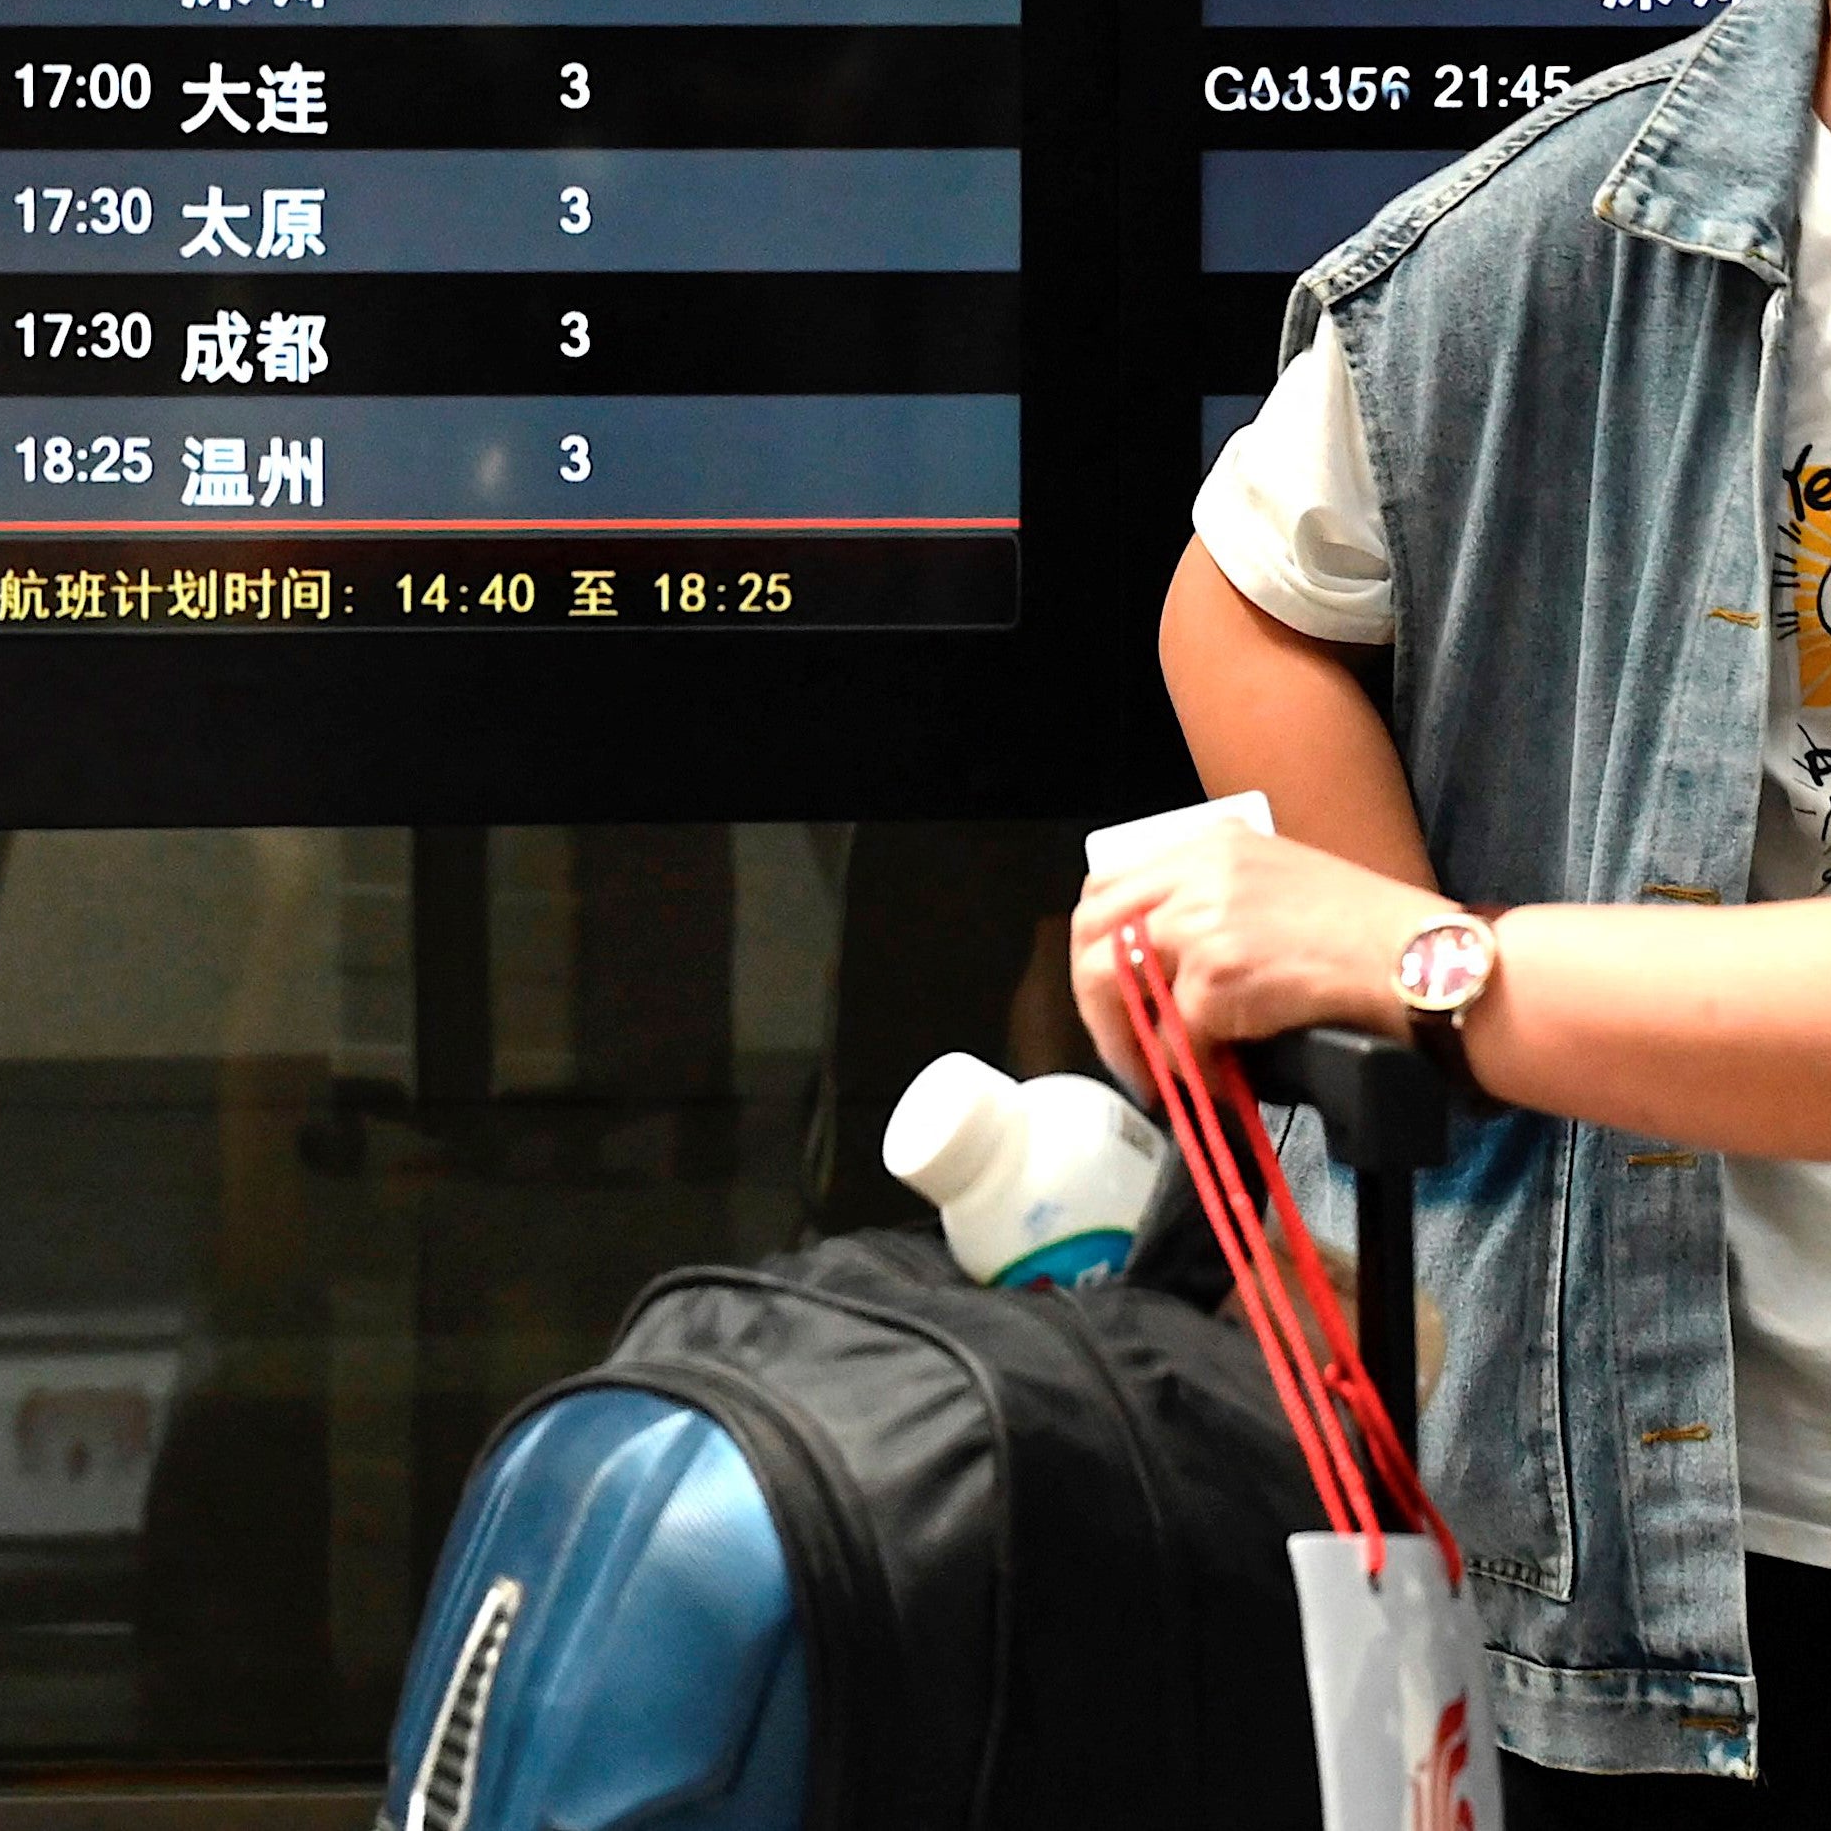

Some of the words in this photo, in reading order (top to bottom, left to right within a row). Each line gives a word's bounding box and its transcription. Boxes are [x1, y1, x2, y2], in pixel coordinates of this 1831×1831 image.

[14, 435, 154, 485] 18:25
[180, 435, 325, 509] 温州
[559, 433, 592, 483] 3
[397, 572, 536, 614] 14:40
[568, 569, 618, 617] 至
[654, 571, 793, 613] 18:25
